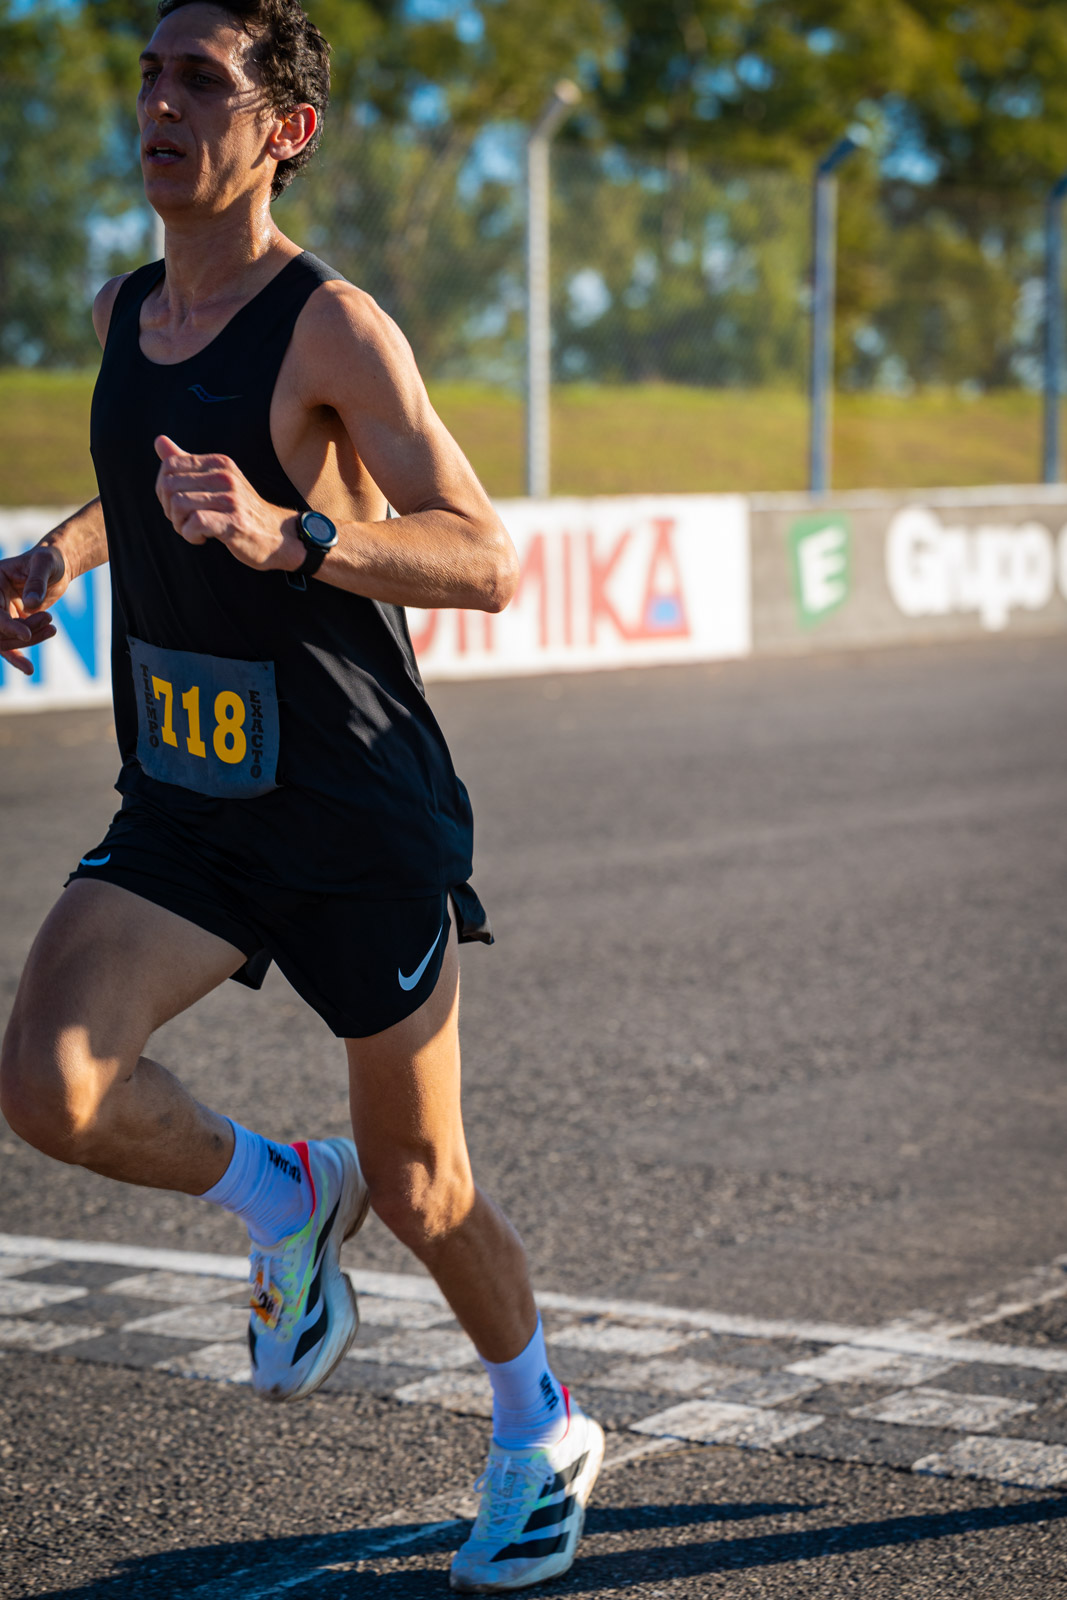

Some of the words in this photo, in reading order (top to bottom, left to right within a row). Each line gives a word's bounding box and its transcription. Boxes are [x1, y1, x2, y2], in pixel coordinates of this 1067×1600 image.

[403, 517, 691, 660] MIKA
[885, 505, 1054, 632] Grupo
[140, 663, 160, 748] TIEMPO
[151, 675, 247, 764] 718
[248, 689, 264, 779] EXACTO
